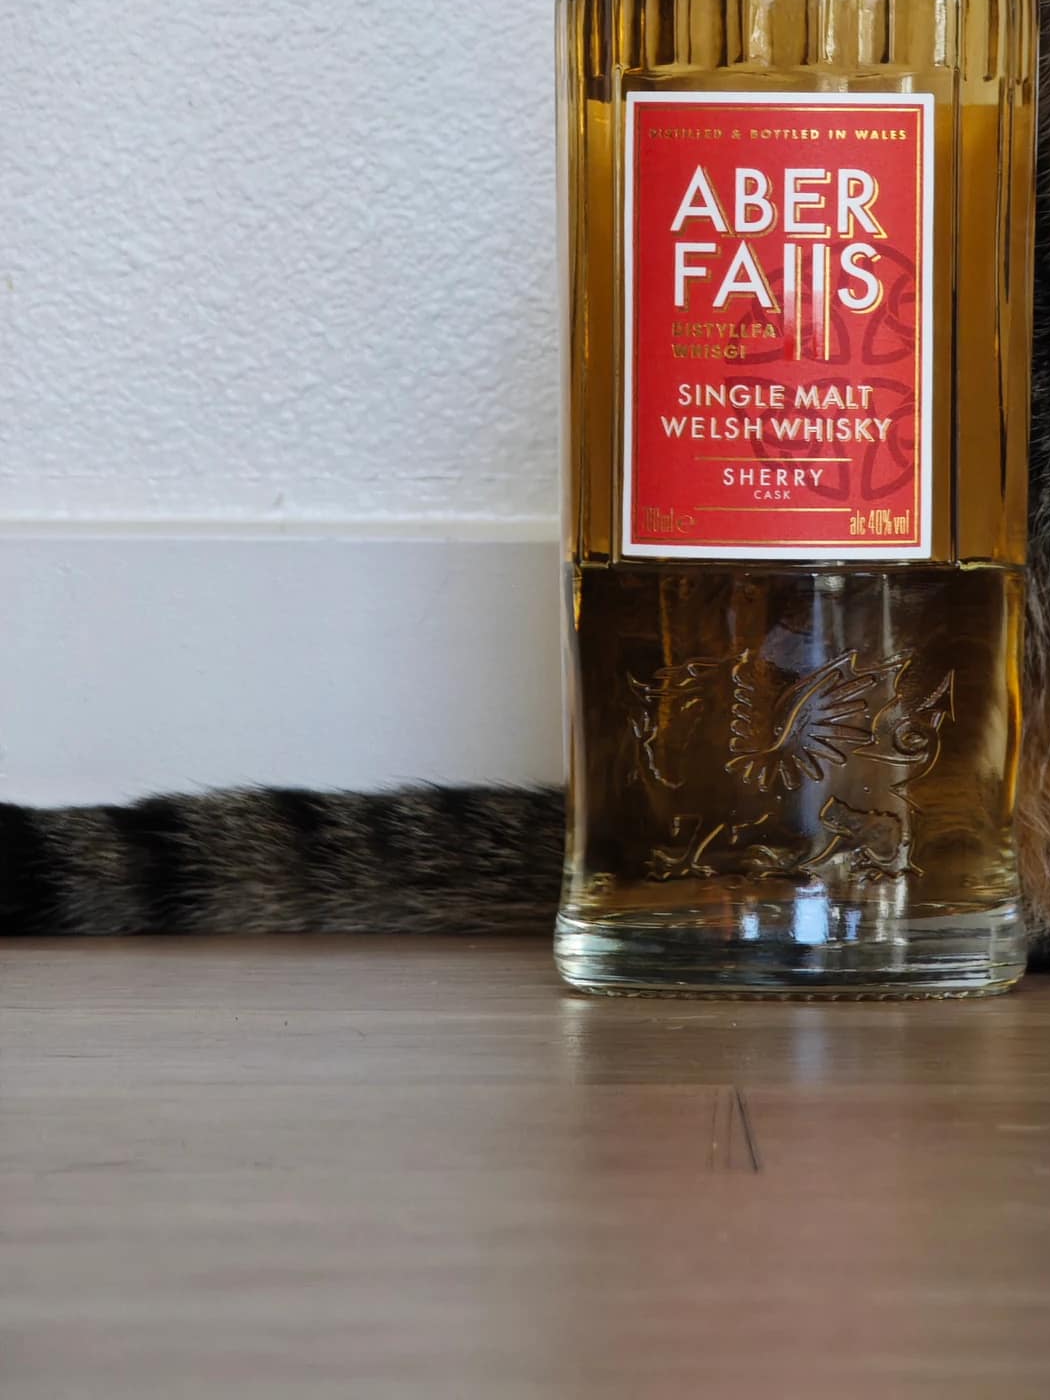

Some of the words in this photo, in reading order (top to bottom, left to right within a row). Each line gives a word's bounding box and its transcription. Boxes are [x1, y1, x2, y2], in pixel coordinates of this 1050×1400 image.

[731, 129, 742, 140] &
[750, 129, 820, 140] BOTTLED
[828, 130, 847, 140] IN
[855, 130, 907, 141] WALES
[670, 165, 888, 239] ABER
[671, 322, 777, 338] DISTYLLFA
[671, 344, 746, 359] WHISGI
[678, 383, 785, 409] SINGLE
[794, 385, 873, 410] MALT
[660, 416, 763, 441] WELSH
[770, 418, 893, 442] WHISKY
[722, 467, 824, 487] SHERRY
[753, 489, 792, 500] CASK
[850, 509, 866, 536] alc
[867, 508, 892, 536] 40%
[893, 509, 910, 536] vol
